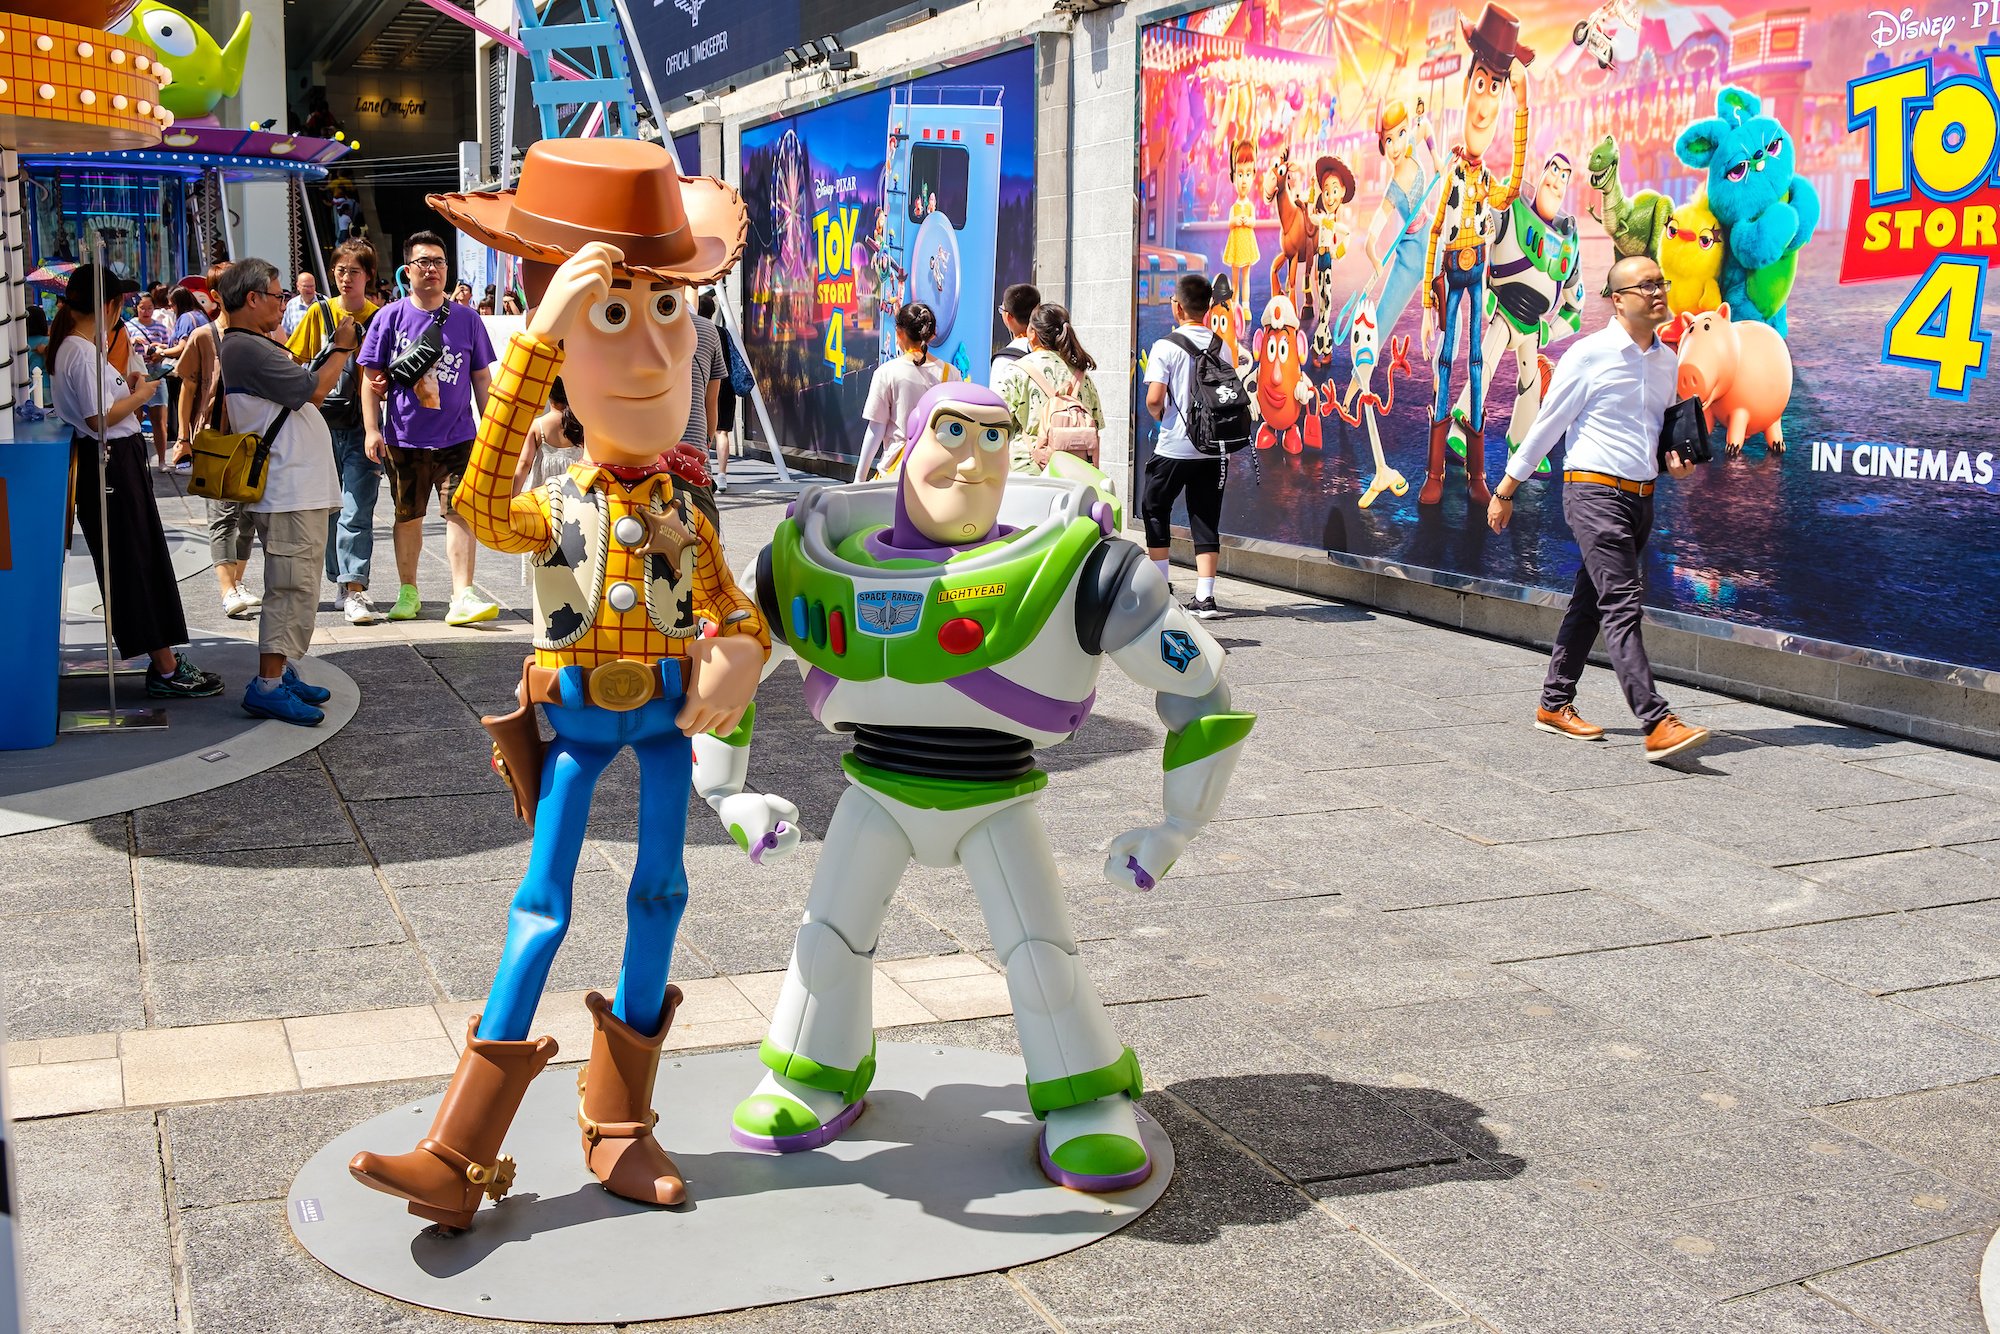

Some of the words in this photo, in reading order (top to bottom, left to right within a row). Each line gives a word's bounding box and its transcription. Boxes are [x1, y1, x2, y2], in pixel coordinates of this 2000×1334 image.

[665, 48, 691, 76] OFFICIAL
[691, 31, 729, 63] TIMEKEEPER
[354, 97, 380, 113] Lane
[380, 98, 426, 119] Crawford
[1847, 45, 2000, 207] TO
[836, 175, 857, 193] PIXAR
[812, 202, 862, 282] TOY
[1863, 204, 2000, 251] STOR
[816, 281, 853, 305] STORY
[823, 306, 847, 386] 4
[1881, 252, 1992, 403] 4
[394, 339, 436, 378] VLTN
[1811, 441, 1843, 473] IN
[1851, 444, 1994, 485] CINEMAS
[859, 592, 887, 601] SPACE
[891, 592, 923, 602] RANGER
[939, 584, 1004, 602] LIGHTYEAR
